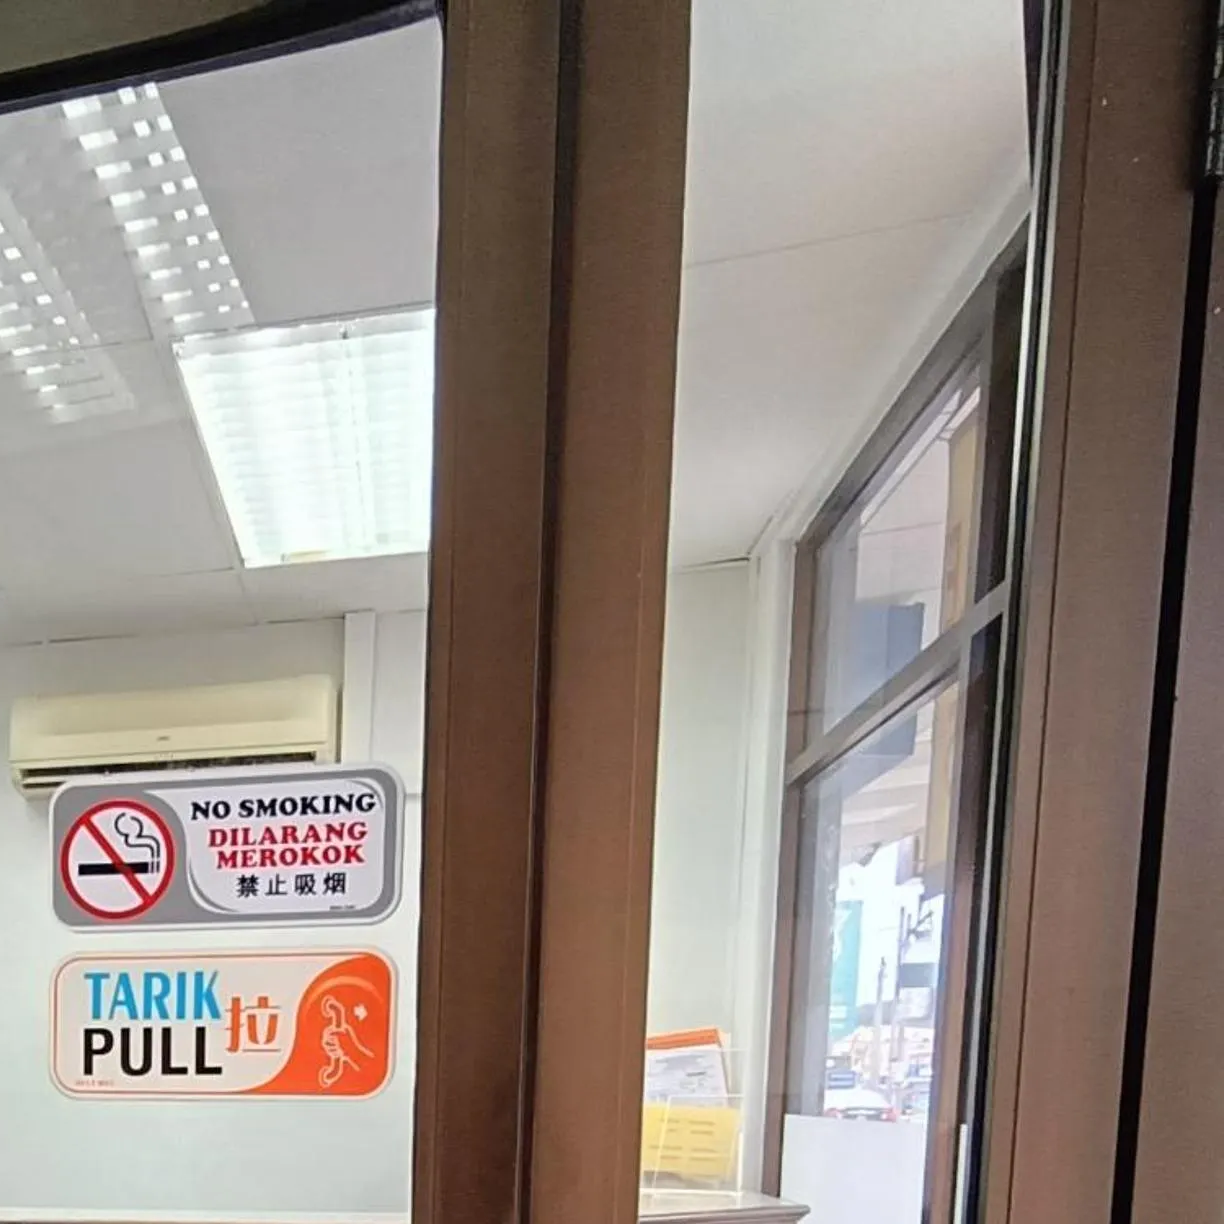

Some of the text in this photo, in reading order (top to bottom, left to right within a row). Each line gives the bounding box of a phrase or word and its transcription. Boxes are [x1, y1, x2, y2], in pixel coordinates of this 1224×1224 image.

[191, 793, 376, 821] NO SMOKING
[208, 822, 368, 848] DILARANG
[216, 845, 365, 869] MEROKOK
[237, 873, 346, 897] 禁止吸烟
[84, 970, 221, 1020] TARIK
[225, 996, 281, 1052] 拉
[83, 1027, 222, 1076] PULL
